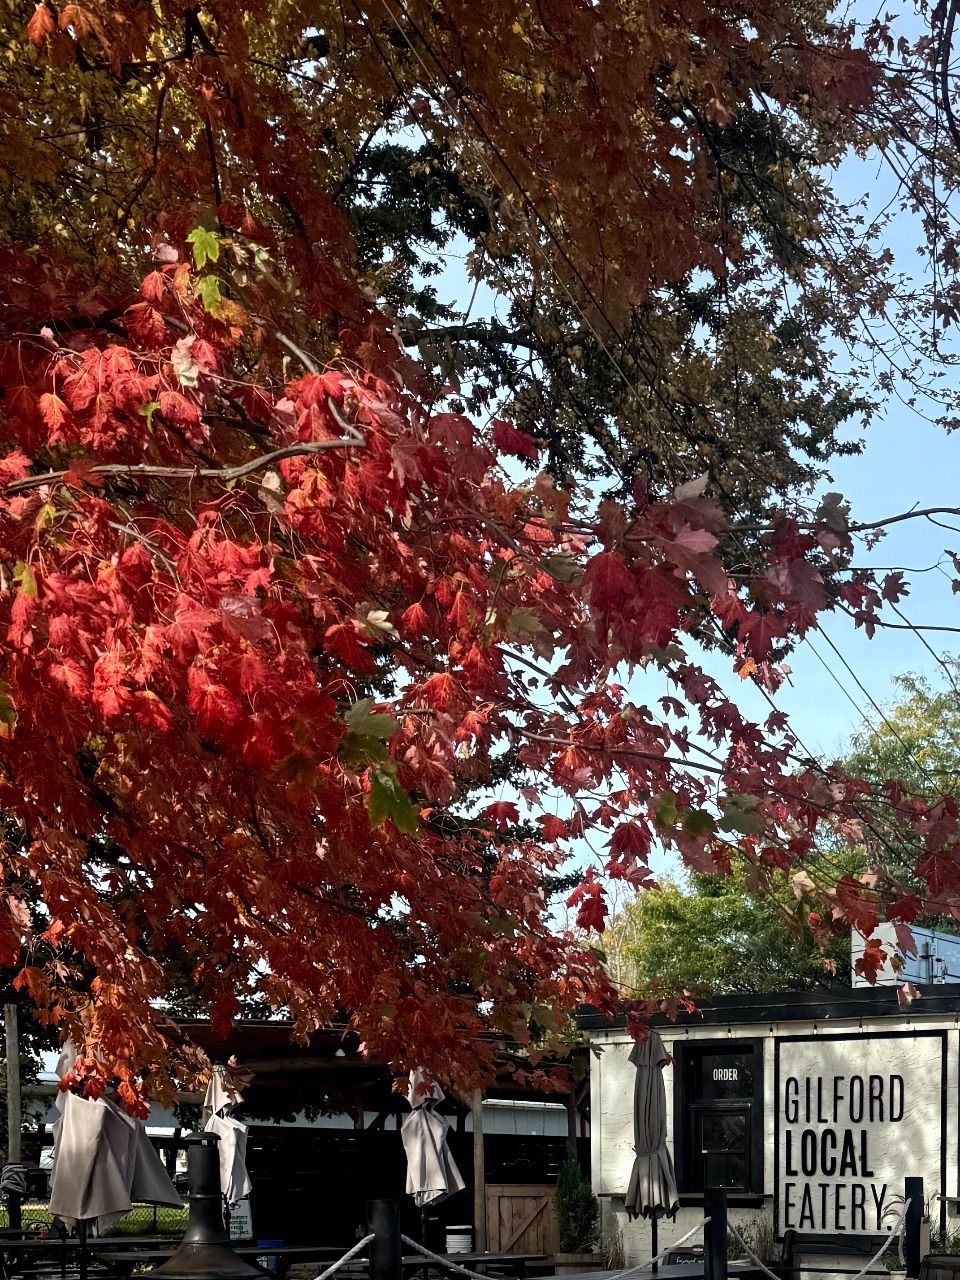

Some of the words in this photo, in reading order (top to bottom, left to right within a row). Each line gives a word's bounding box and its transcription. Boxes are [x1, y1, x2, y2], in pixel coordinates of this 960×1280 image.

[713, 1068, 738, 1081] ORDER
[785, 1075, 904, 1123] GILFORD
[785, 1129, 875, 1177] LOCAL
[785, 1183, 892, 1231] EATERY.
